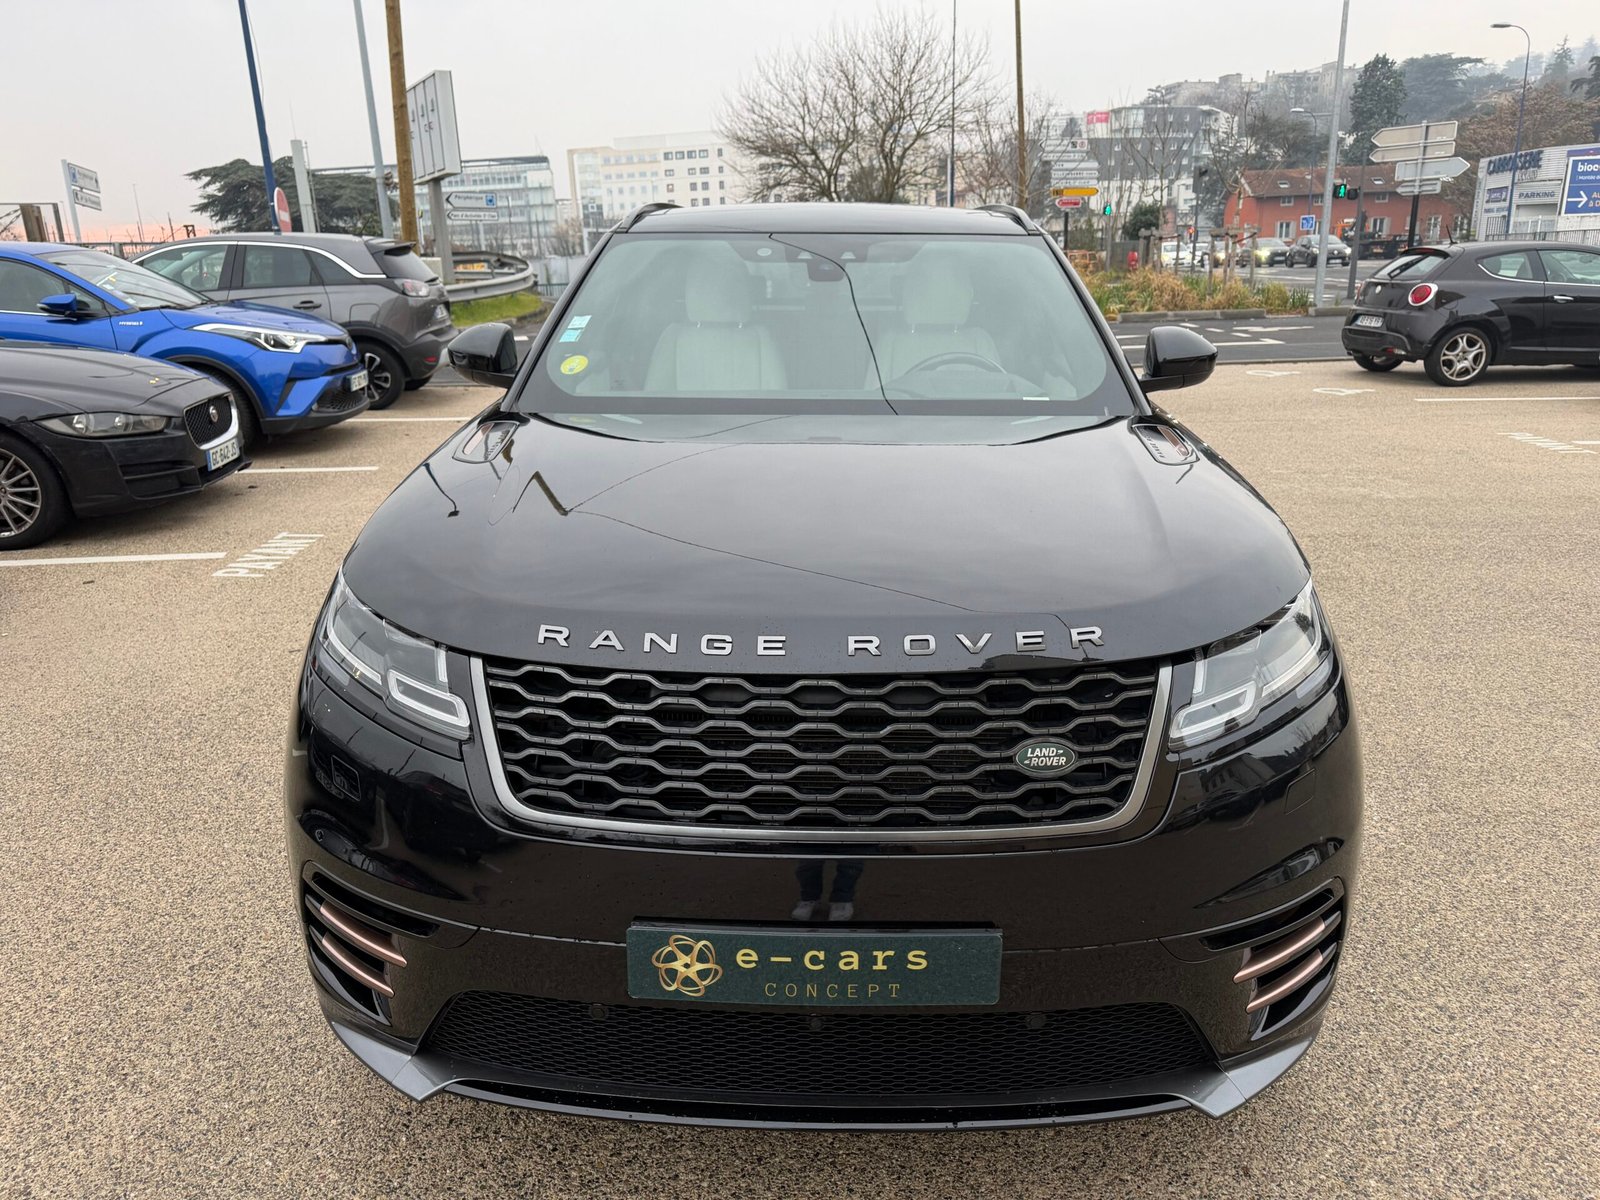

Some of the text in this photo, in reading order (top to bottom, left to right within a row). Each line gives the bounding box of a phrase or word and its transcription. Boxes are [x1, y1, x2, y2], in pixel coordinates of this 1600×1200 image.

[1487, 150, 1544, 174] CARROSERIE
[1577, 161, 1600, 172] bioc
[1518, 190, 1555, 199] PARKING
[211, 531, 325, 577] PAYANT
[537, 624, 1106, 657] RANGE ROVER
[1027, 747, 1057, 757] LAND
[1030, 756, 1067, 767] ROVER
[735, 947, 929, 971] e-cars
[764, 981, 901, 999] CONCEPT
